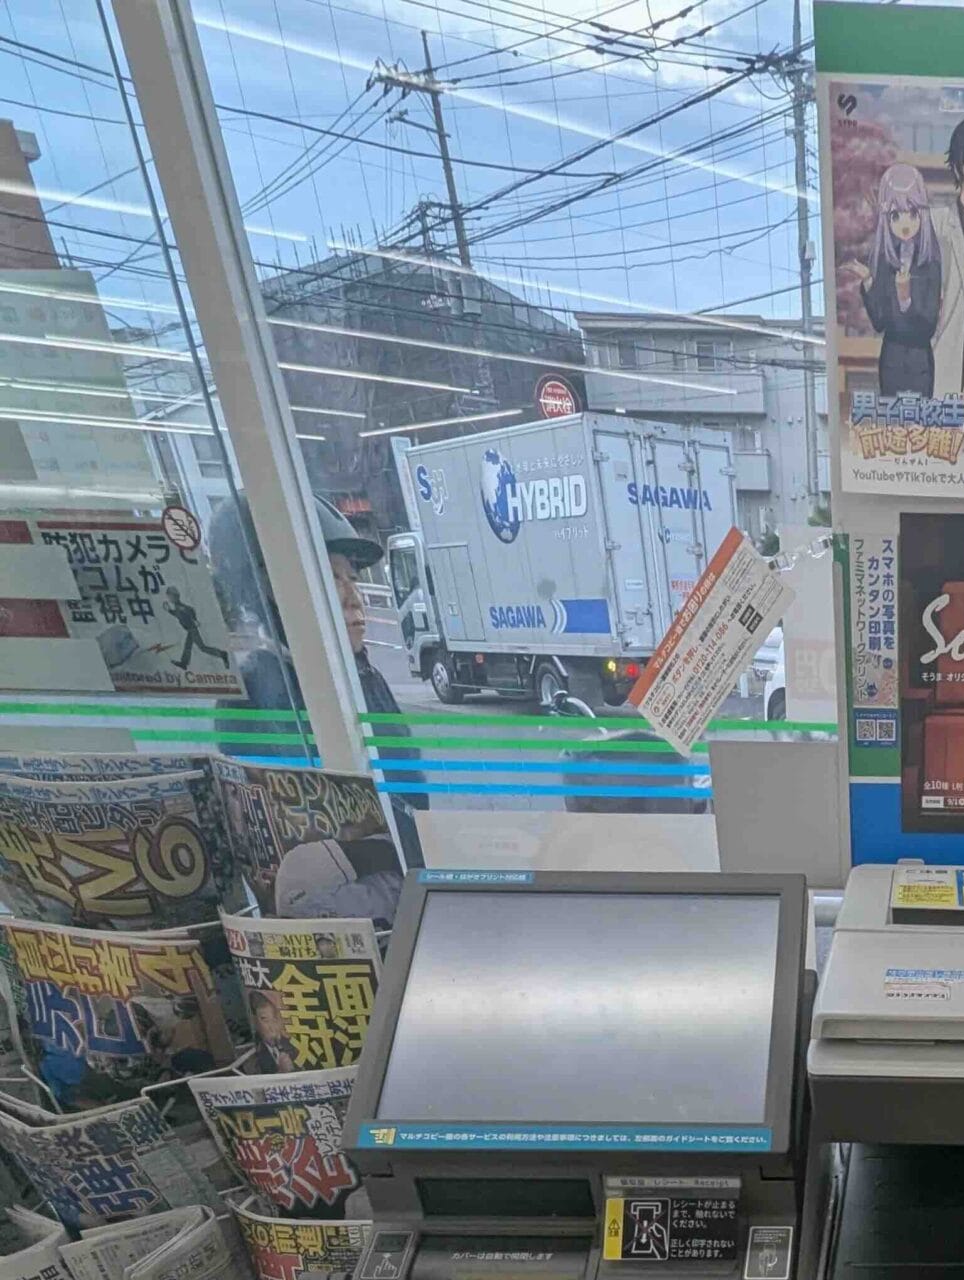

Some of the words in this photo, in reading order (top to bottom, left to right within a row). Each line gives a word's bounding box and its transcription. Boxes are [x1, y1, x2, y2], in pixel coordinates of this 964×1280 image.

[506, 474, 587, 521] HYBRID
[627, 482, 712, 511] SAGAWA
[73, 565, 166, 595] コムが
[882, 539, 895, 650] スマホの写真を
[868, 556, 881, 651] カンタン印刷
[490, 605, 546, 630] SAGAWA
[166, 672, 181, 686] by
[185, 671, 238, 685] Camera
[284, 934, 312, 946] MVP
[672, 1200, 736, 1209] レシートが止まる
[672, 1220, 708, 1228] ください。
[671, 1239, 735, 1247] 正しく印字されない
[451, 1250, 553, 1262] カバーは自動で開閉します
[671, 1249, 723, 1258] ことがあります。
